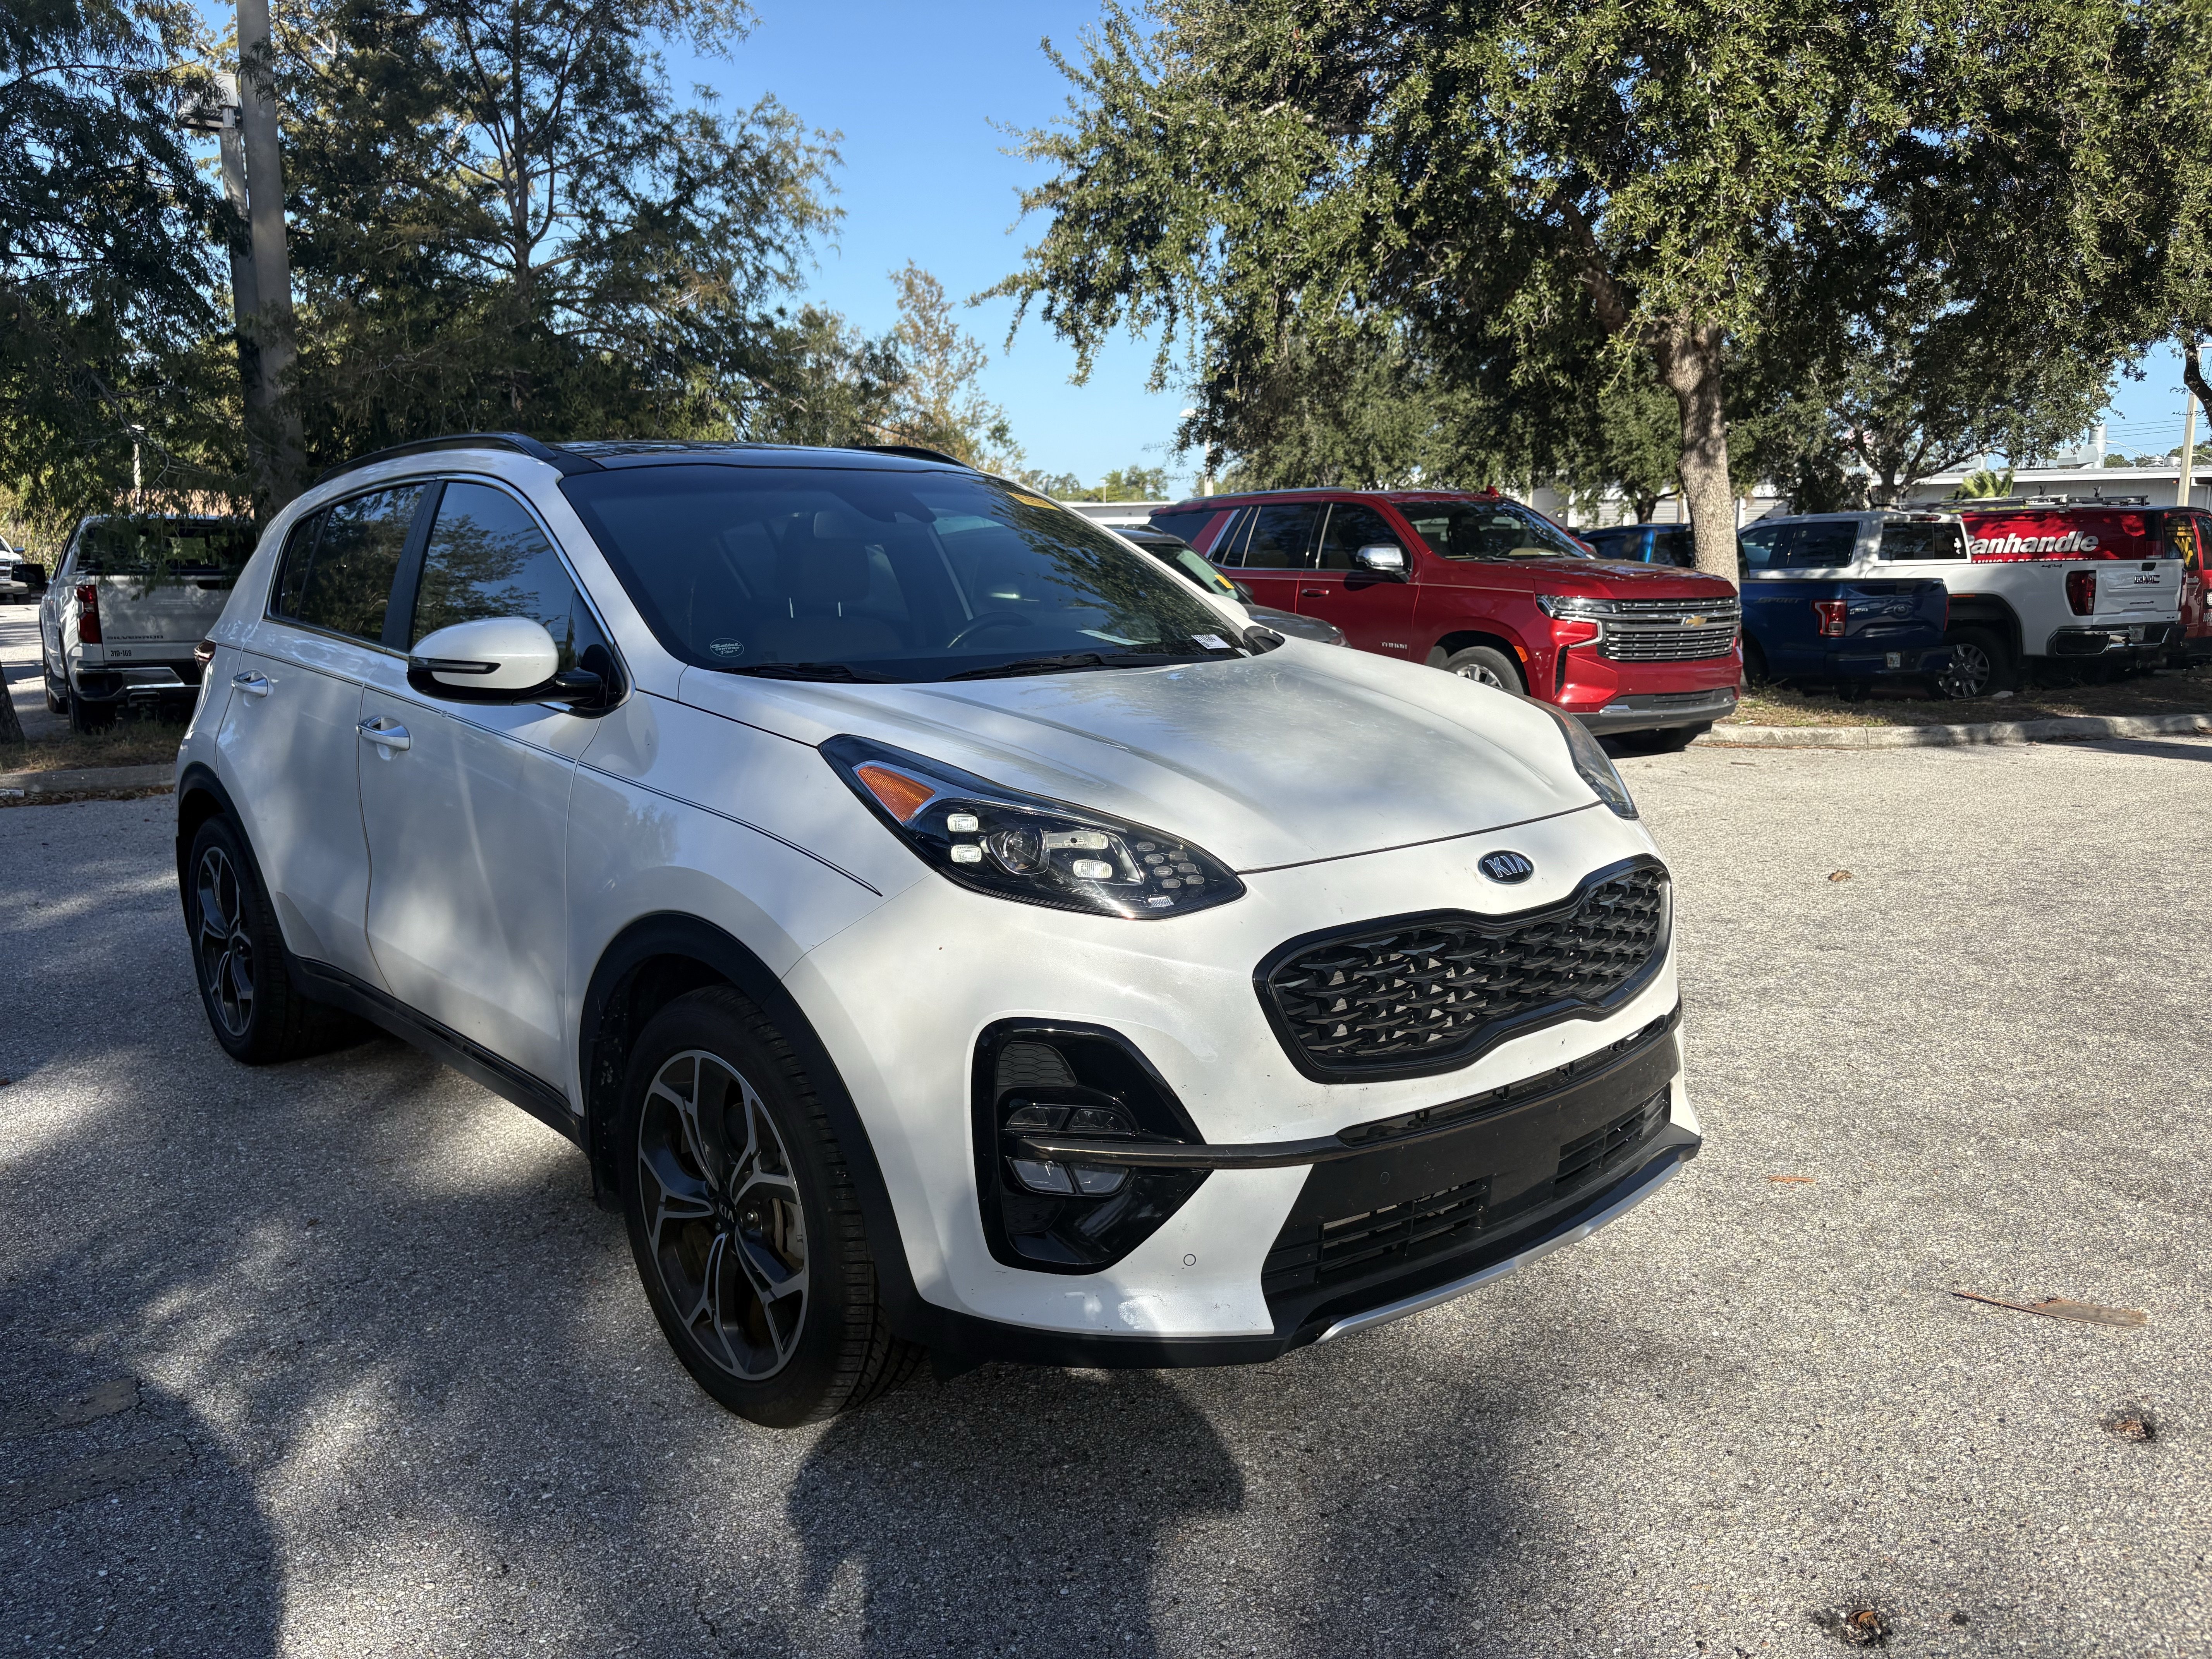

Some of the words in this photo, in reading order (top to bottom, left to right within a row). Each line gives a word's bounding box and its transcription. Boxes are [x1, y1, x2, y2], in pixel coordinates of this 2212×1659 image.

[2134, 575, 2160, 584] GMC
[1485, 854, 1531, 878] KIA
[719, 1202, 735, 1223] KIA
